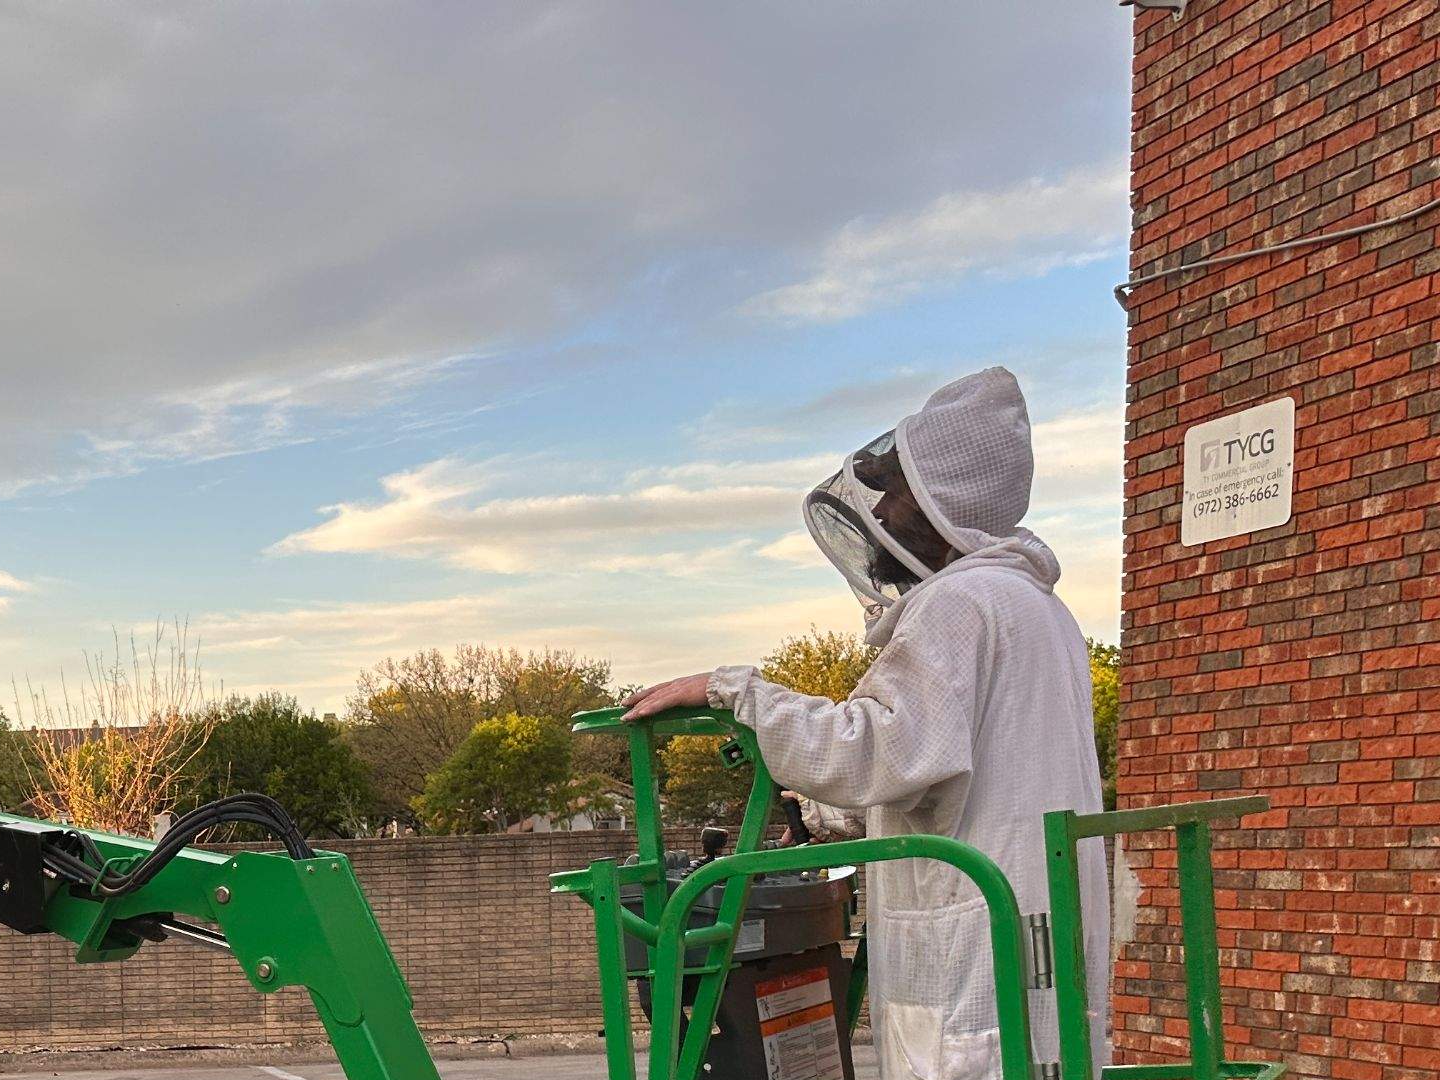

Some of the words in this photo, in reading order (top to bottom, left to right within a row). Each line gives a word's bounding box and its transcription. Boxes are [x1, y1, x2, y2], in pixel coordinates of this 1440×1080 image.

[1223, 428, 1274, 465] TYCG
[1193, 497, 1222, 518] (972)
[1224, 483, 1279, 510] 386-6662
[1196, 488, 1214, 500] case
[1213, 483, 1222, 494] of
[1222, 474, 1266, 492] emergency
